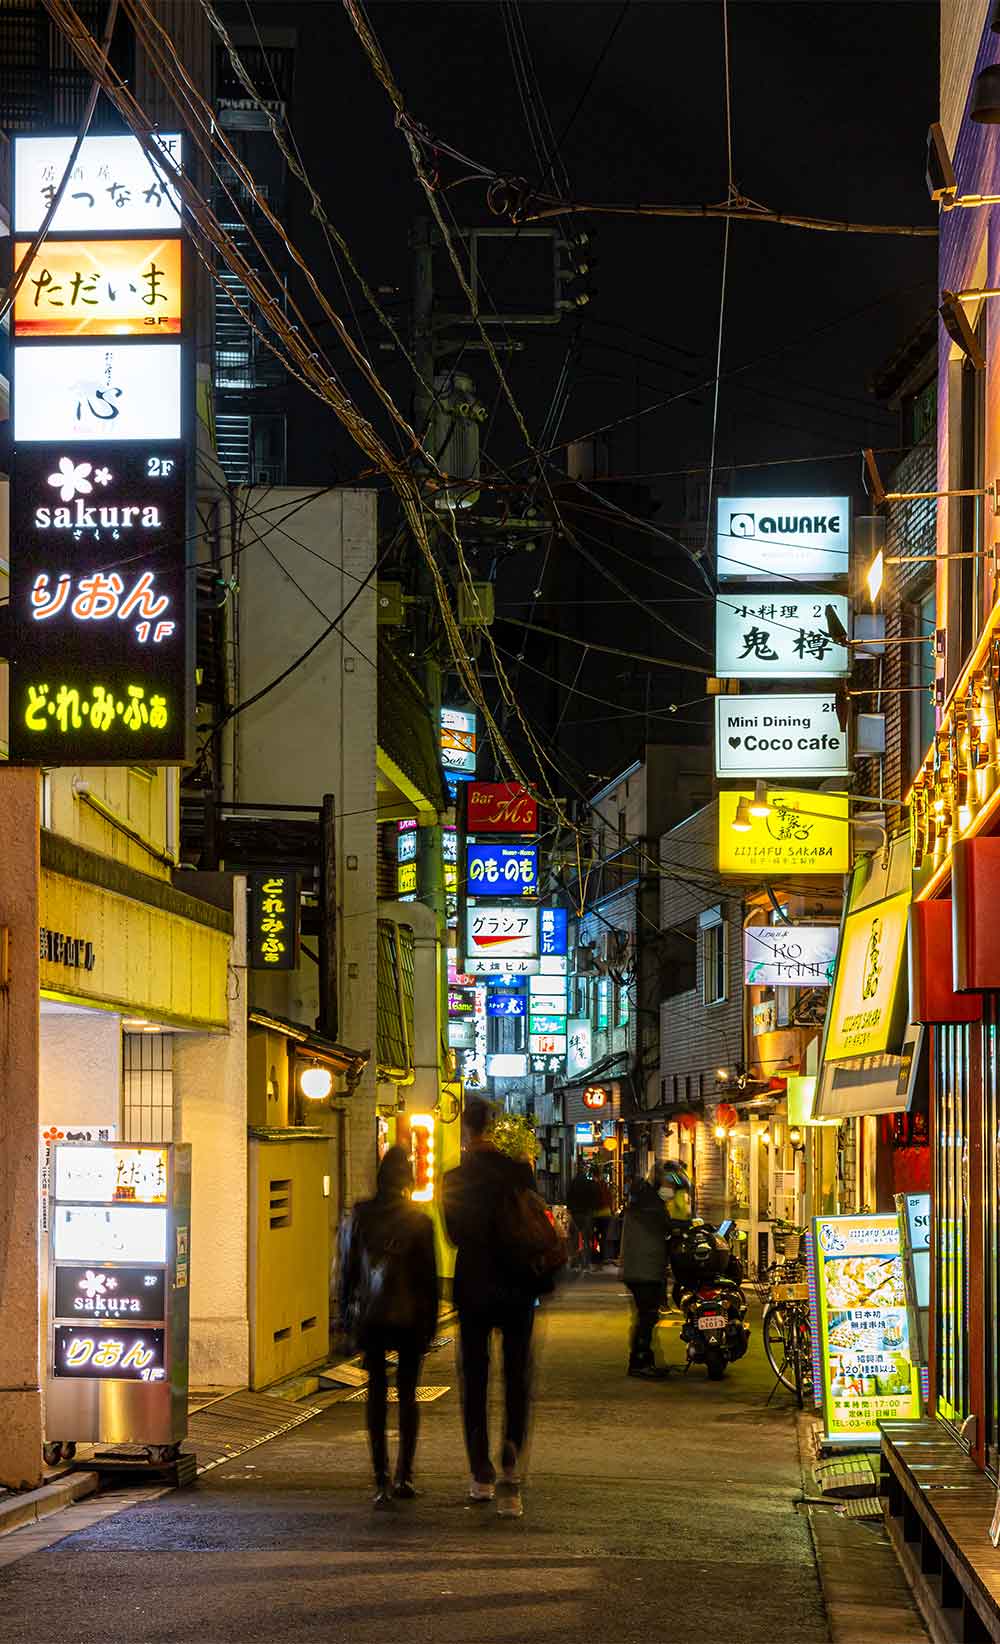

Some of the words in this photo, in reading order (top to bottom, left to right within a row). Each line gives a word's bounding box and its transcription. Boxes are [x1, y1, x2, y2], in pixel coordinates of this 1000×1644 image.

[31, 261, 168, 308] ただいま
[143, 316, 169, 326] 3F
[76, 387, 123, 421] 心
[147, 457, 174, 477] 2F
[35, 498, 162, 529] sakura
[73, 529, 120, 541] さくら
[31, 571, 169, 620] りおん
[735, 603, 800, 620] 小料理
[135, 620, 175, 643] 1F
[727, 716, 758, 728] Mini
[762, 715, 811, 729] Dining
[743, 735, 793, 751] Coco
[797, 733, 841, 751] cafe
[471, 791, 494, 804] Bar
[787, 846, 834, 857] SAKABA
[522, 886, 536, 895] 2F
[472, 917, 529, 934] グラシア
[909, 1199, 921, 1207] 2F
[73, 1294, 141, 1312] sakura
[854, 1310, 881, 1319] 日本初
